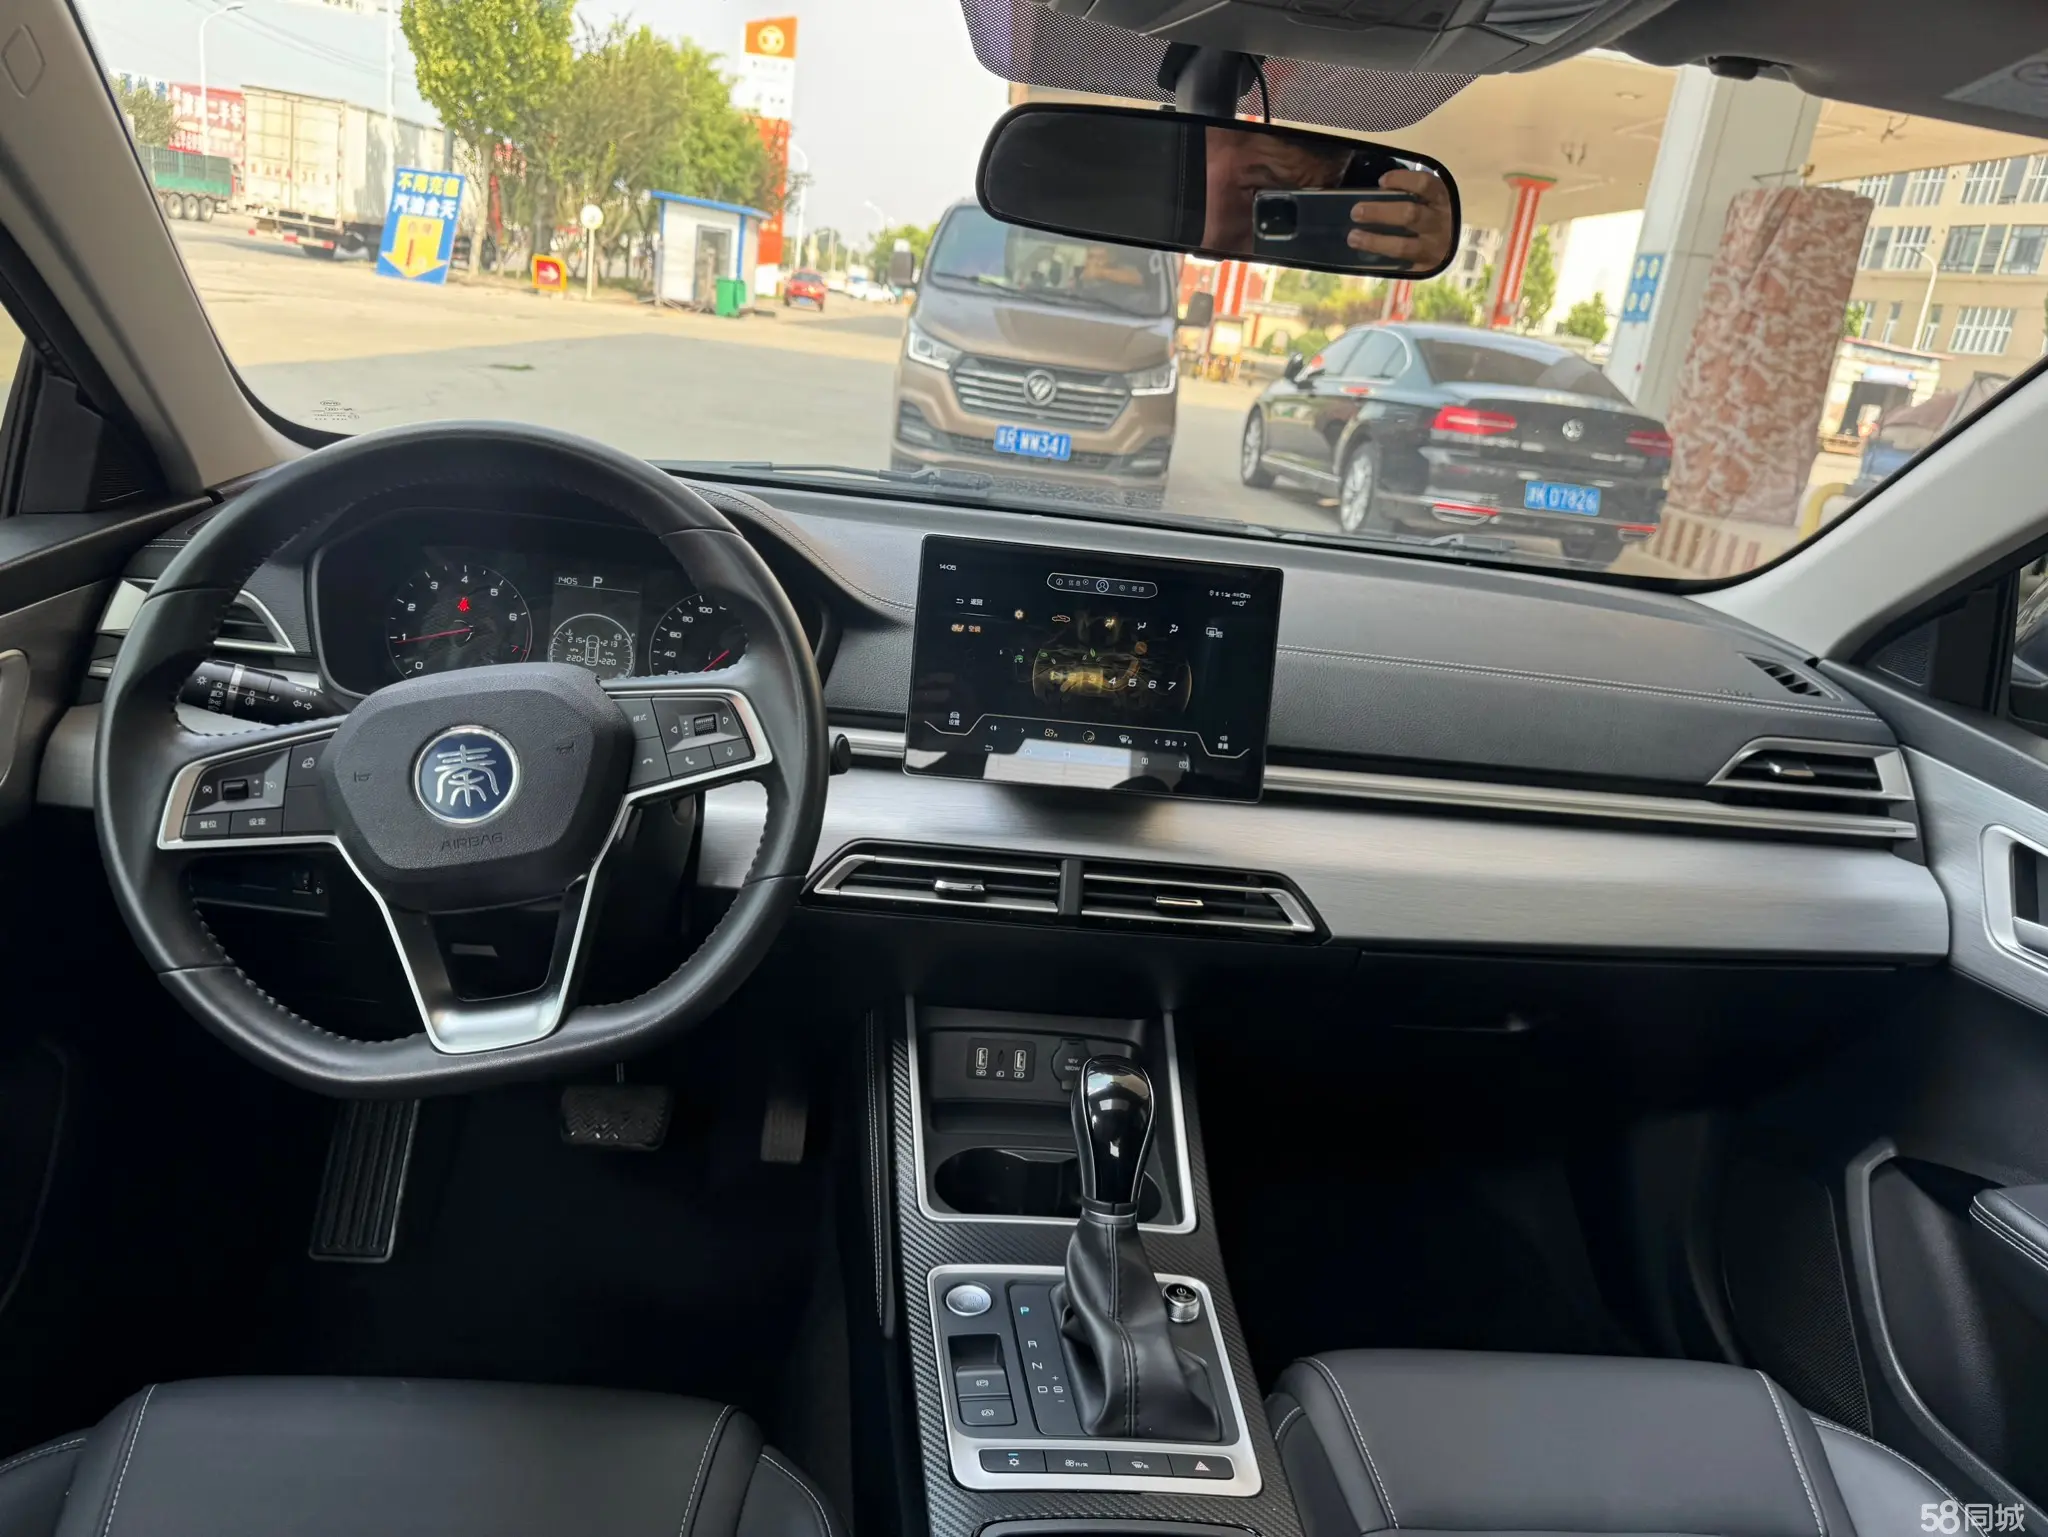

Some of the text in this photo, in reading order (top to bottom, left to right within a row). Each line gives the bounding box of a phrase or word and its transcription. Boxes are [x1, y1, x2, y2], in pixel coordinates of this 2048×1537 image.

[461, 576, 469, 584] 4
[592, 576, 603, 588] P
[430, 582, 438, 590] 3
[490, 588, 499, 596] 5
[407, 603, 416, 611] 2
[698, 606, 713, 614] 100
[508, 613, 517, 621] 6
[669, 631, 682, 639] 60
[511, 645, 519, 653] 7
[415, 661, 423, 669] 0
[1108, 677, 1117, 686] 4
[1128, 678, 1137, 687] 5
[1148, 680, 1157, 688] 6
[1168, 682, 1177, 691] 7
[200, 819, 217, 829] 复位
[249, 817, 266, 827] 设定
[440, 832, 503, 852] AIRBAG
[1020, 1307, 1030, 1315] P
[1028, 1340, 1037, 1348] R
[1032, 1362, 1043, 1370] N
[1053, 1385, 1063, 1393] S
